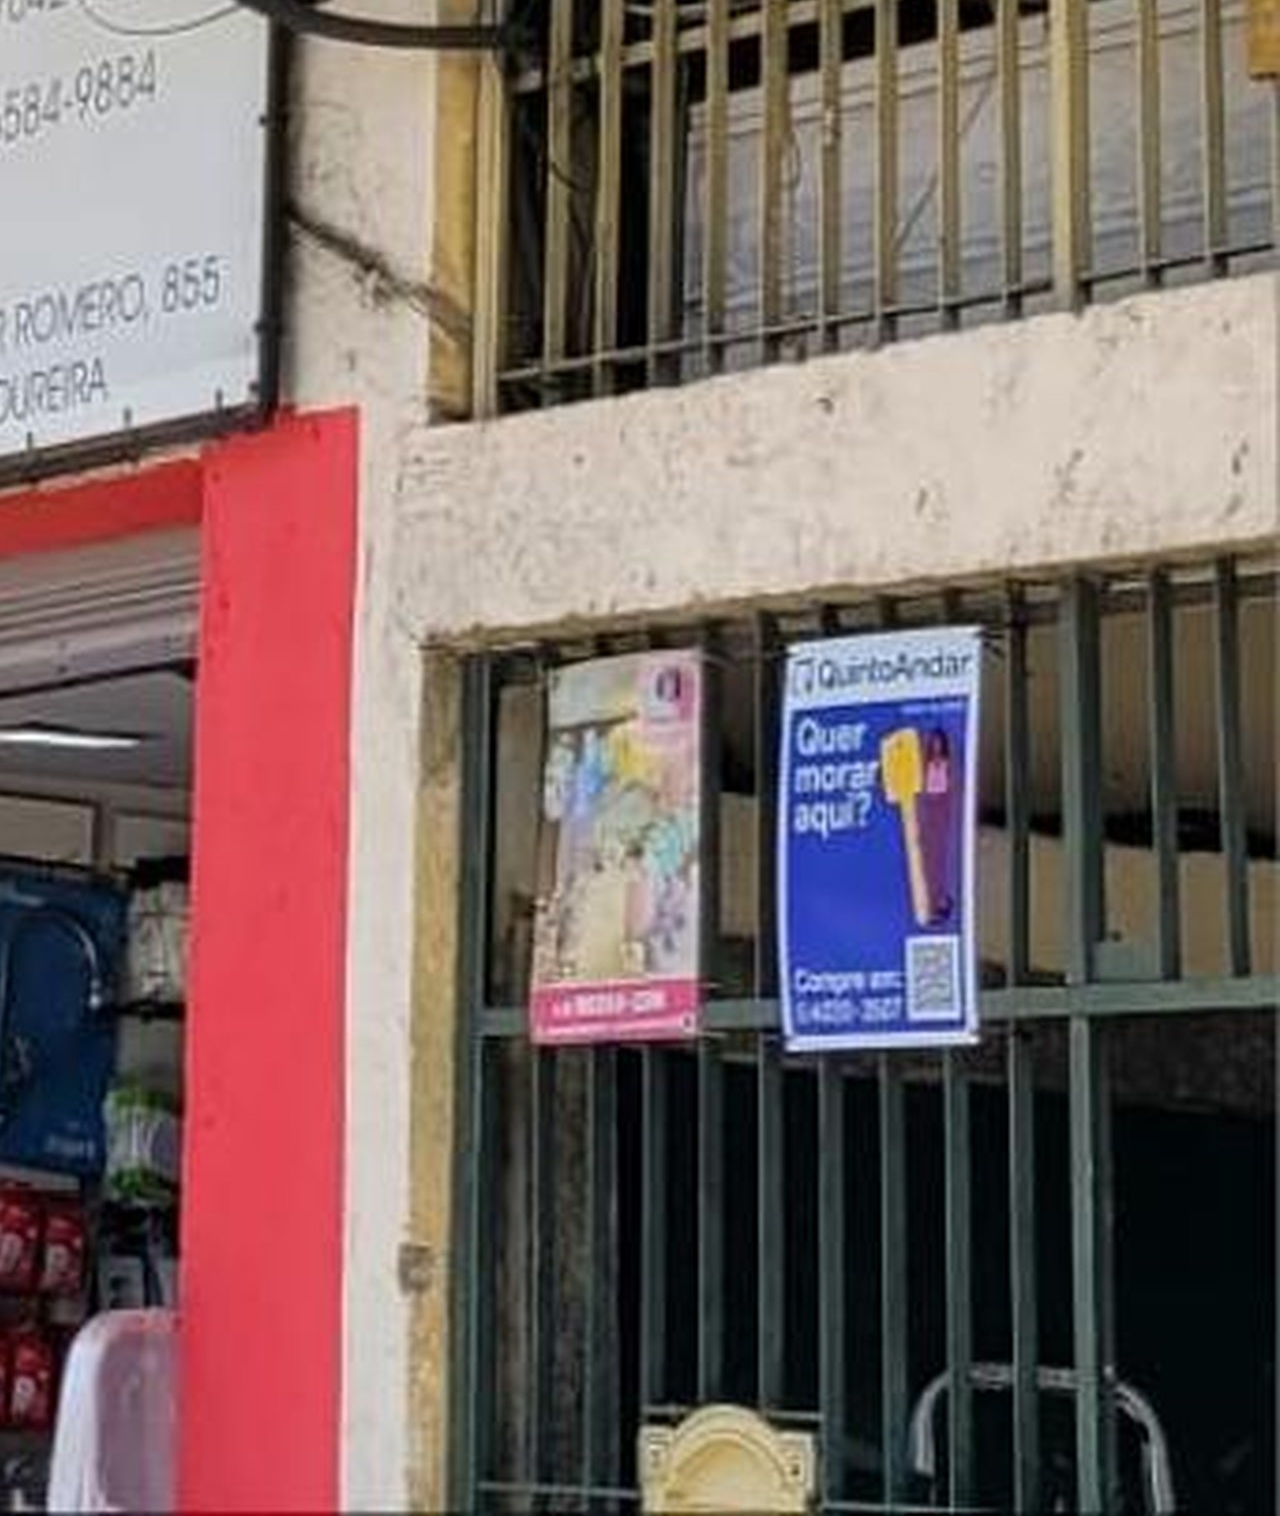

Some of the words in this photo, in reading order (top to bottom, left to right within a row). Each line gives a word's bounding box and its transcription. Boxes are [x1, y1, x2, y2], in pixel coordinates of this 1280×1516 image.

[161, 255, 223, 316] 855
[818, 649, 972, 690] QuintoAndar
[796, 716, 868, 756] Quer
[794, 757, 880, 793] morar
[793, 794, 872, 839] aqui?
